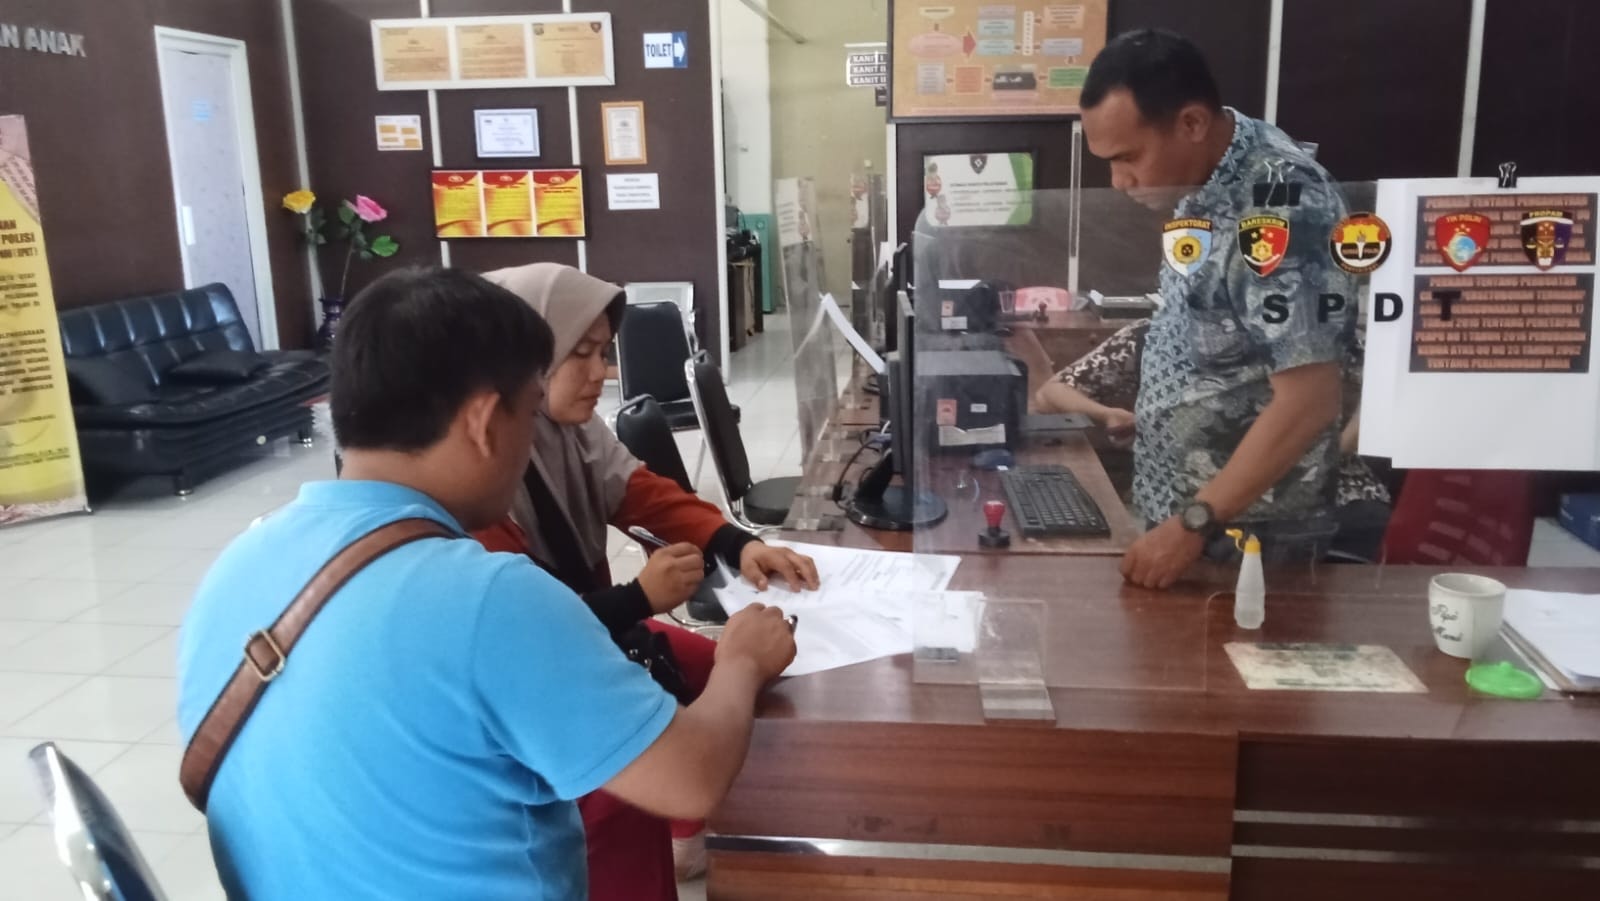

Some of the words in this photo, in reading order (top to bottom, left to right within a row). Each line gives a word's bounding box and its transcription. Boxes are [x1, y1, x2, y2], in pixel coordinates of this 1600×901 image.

[25, 27, 87, 57] ANAK
[645, 43, 672, 57] TOILET
[1529, 210, 1563, 218] PROPAM
[1164, 219, 1211, 230] INSPEKTORAT
[1241, 217, 1285, 228] BARESKRIM
